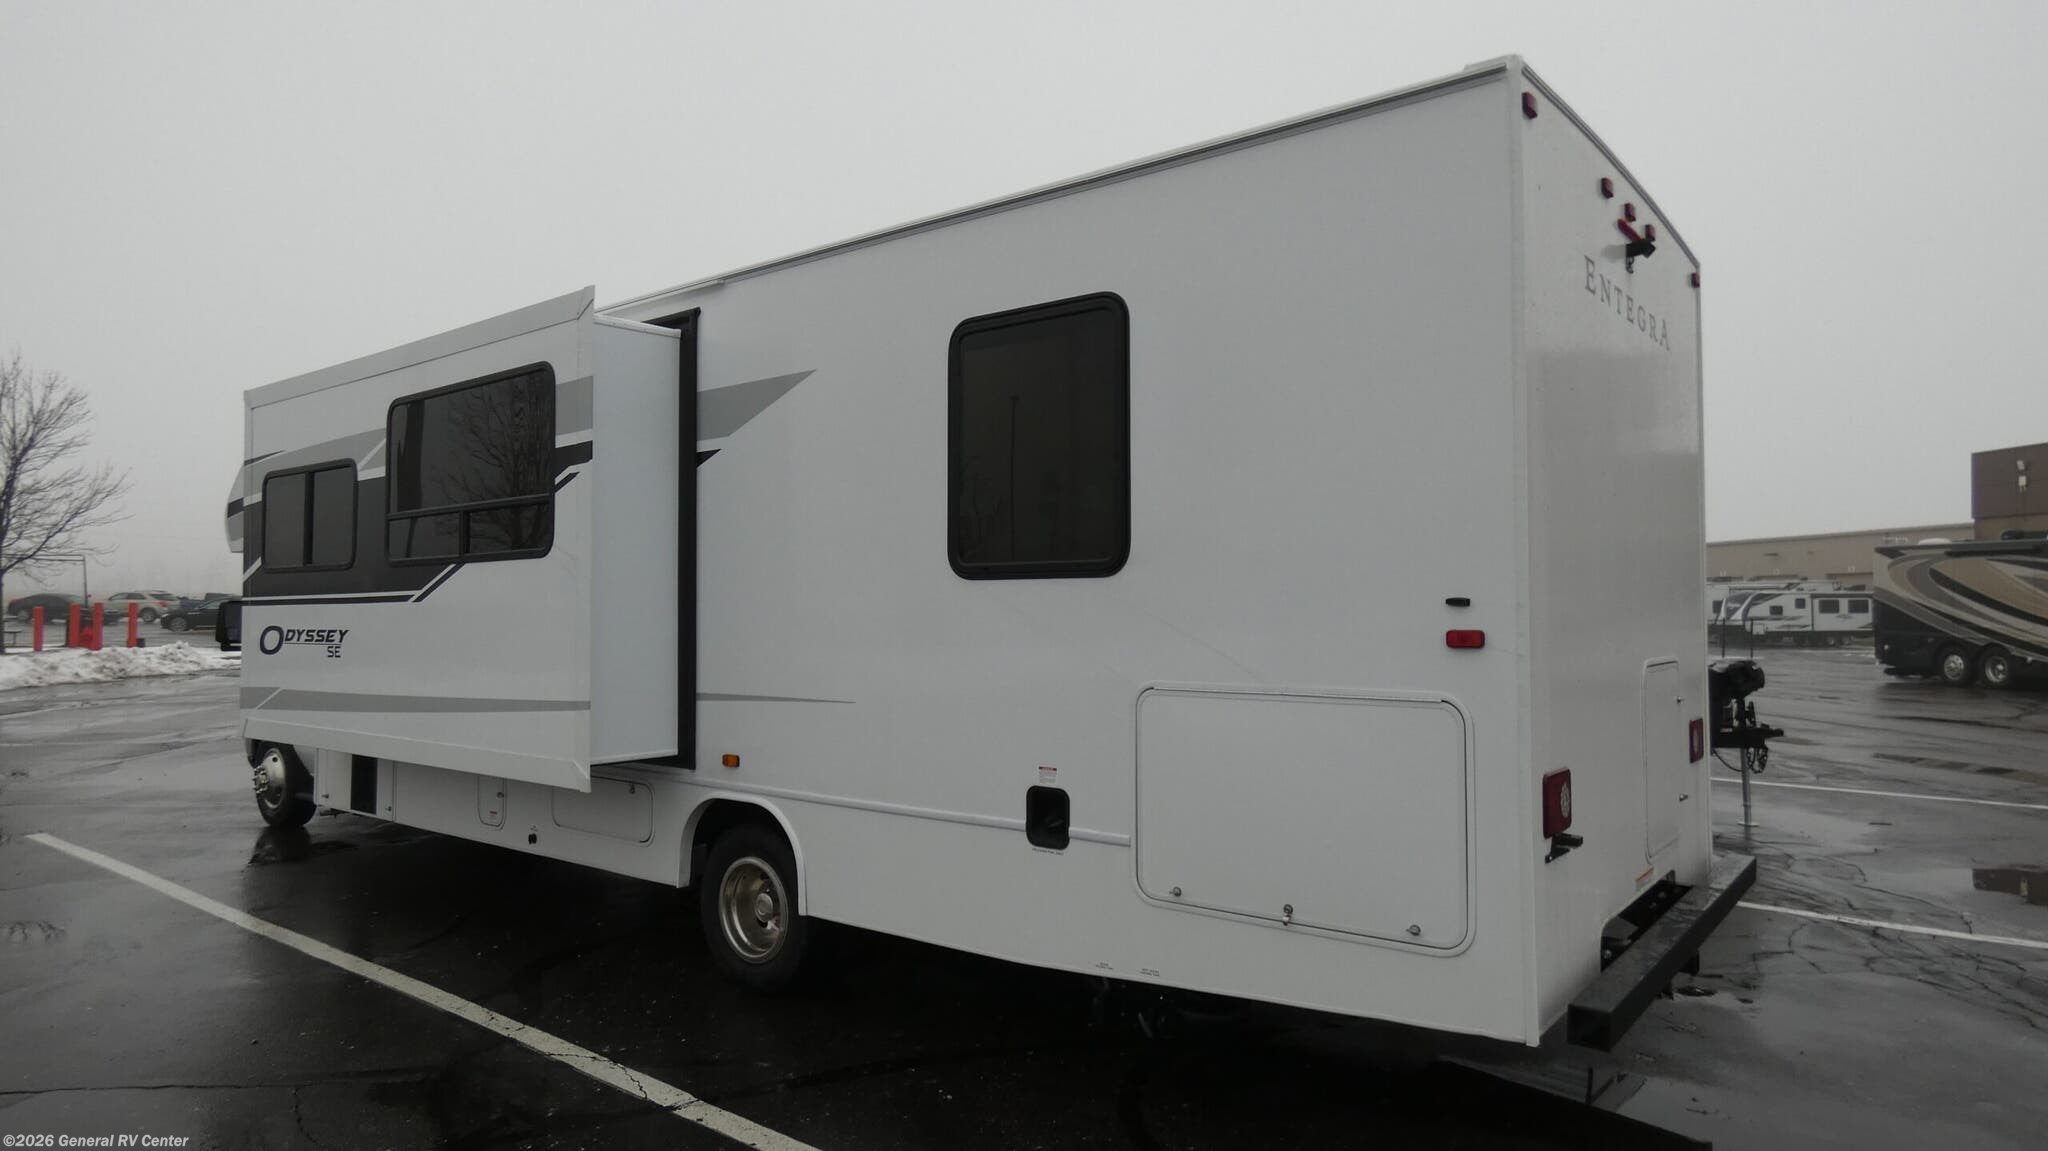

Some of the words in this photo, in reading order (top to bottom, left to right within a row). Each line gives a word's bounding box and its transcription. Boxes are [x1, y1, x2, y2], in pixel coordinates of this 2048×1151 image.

[1584, 254, 1671, 352] ENTEGRA
[259, 625, 349, 655] ODYSSEY
[327, 645, 342, 658] SE
